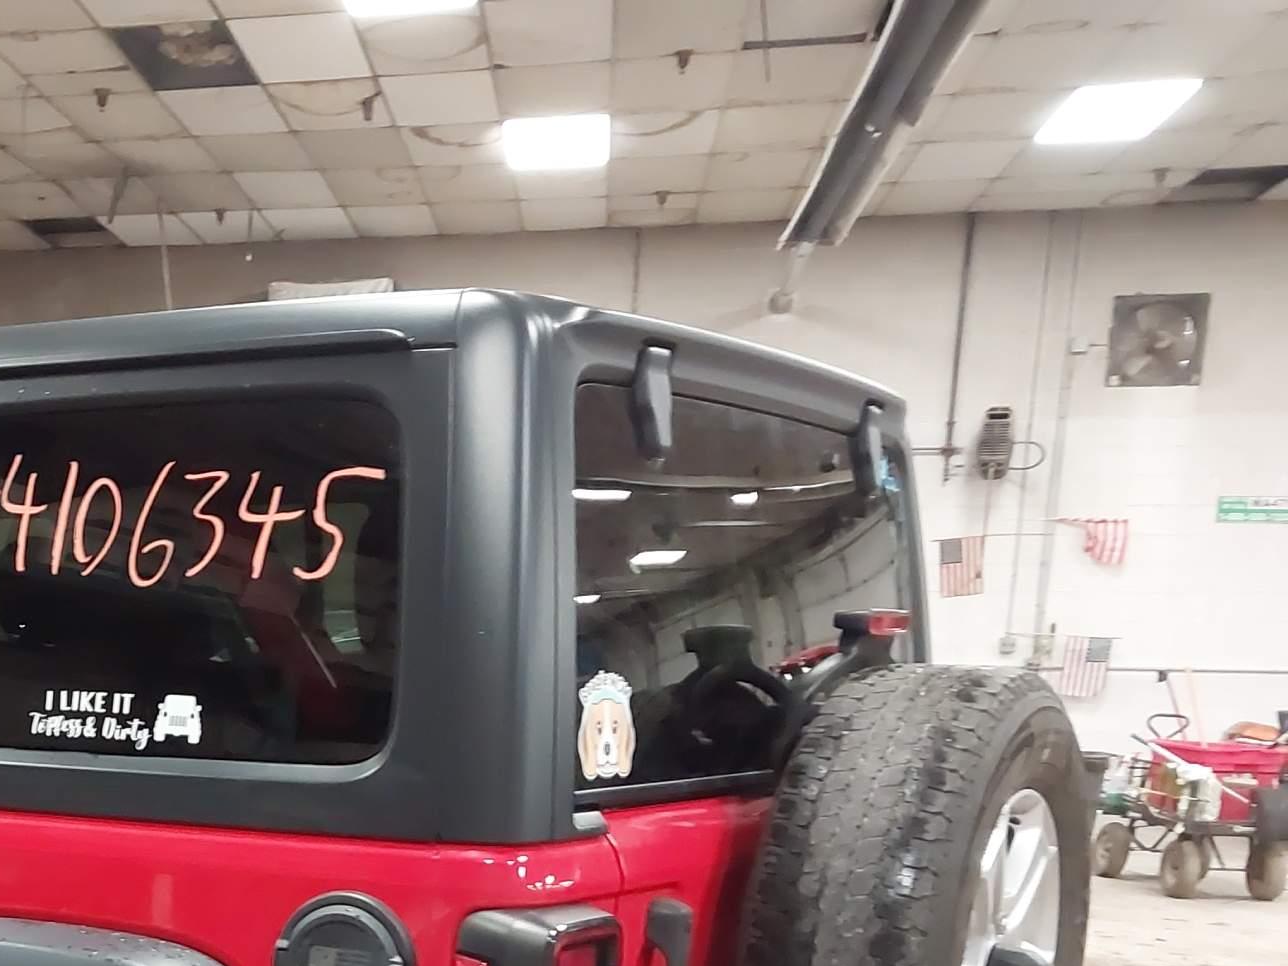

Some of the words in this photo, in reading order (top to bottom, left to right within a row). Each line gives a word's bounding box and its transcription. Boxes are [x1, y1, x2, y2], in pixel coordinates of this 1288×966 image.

[45, 690, 55, 711] I
[59, 690, 108, 713] LIKE
[111, 693, 135, 715] IT
[101, 717, 152, 750] Dirty
